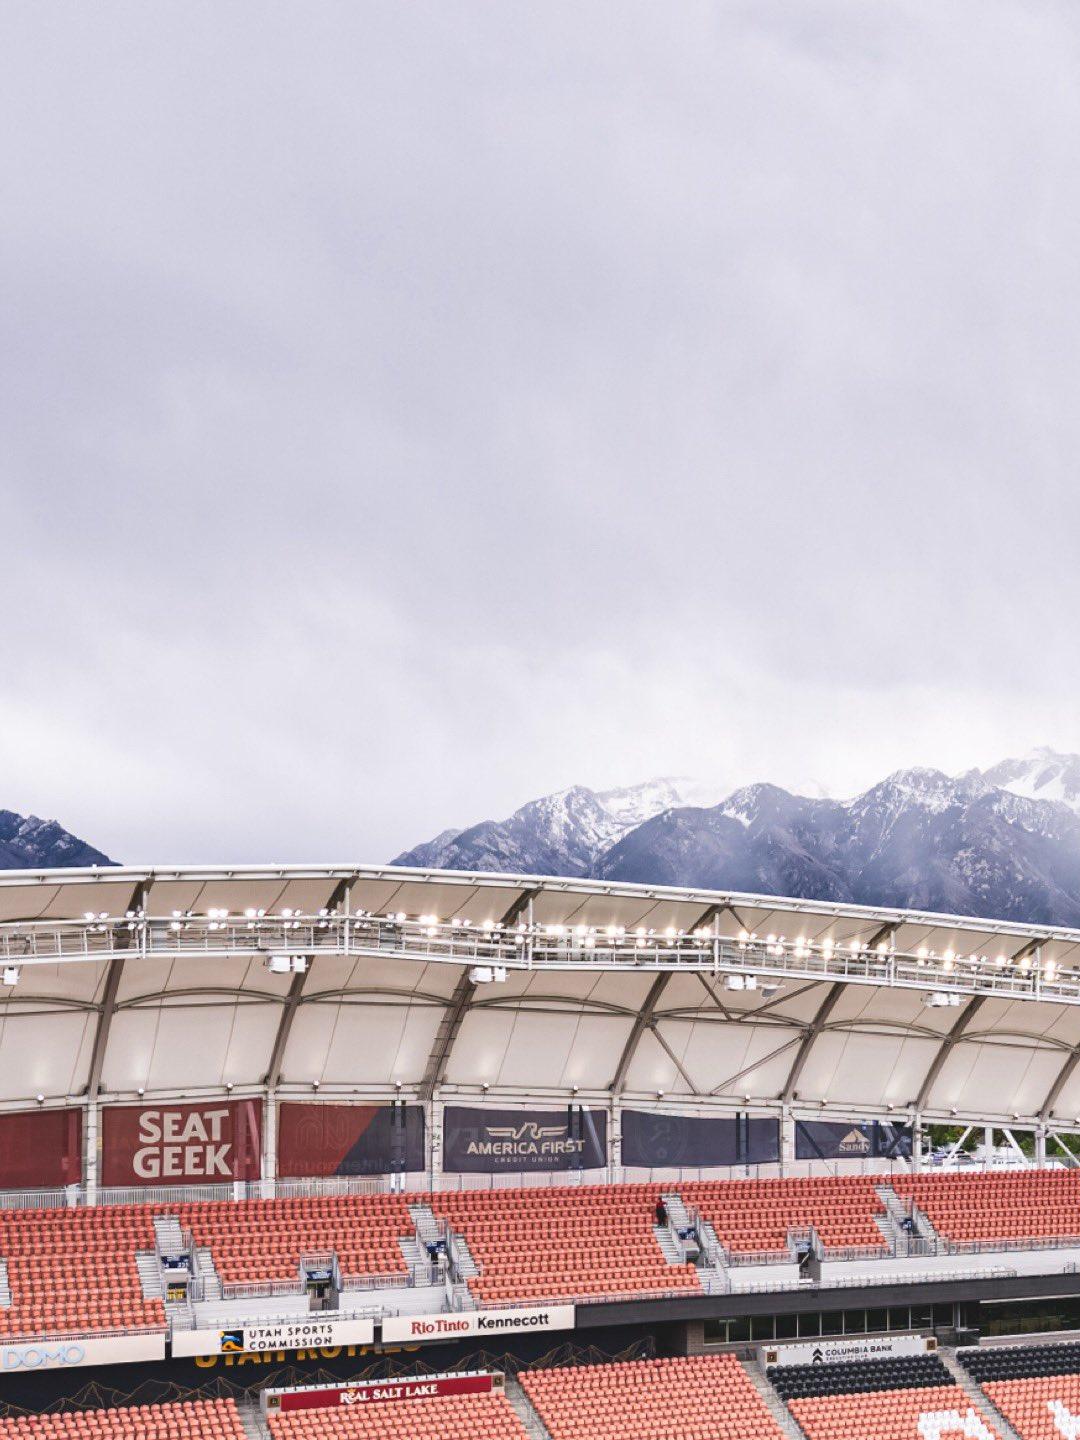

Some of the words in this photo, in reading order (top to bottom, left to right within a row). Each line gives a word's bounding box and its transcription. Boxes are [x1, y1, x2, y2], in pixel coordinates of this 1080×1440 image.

[139, 1109, 229, 1143] SEAT
[466, 1141, 538, 1155] AMERICA
[541, 1139, 585, 1154] FIRST
[840, 1141, 871, 1154] Sandy
[133, 1143, 233, 1178] GEEK
[478, 1313, 549, 1329] Kennecott
[250, 1328, 282, 1338] UTAH
[287, 1324, 333, 1336] SPORTS
[250, 1336, 333, 1350] COMMISSION
[825, 1346, 868, 1356] COLUMBIA
[870, 1345, 892, 1353] BANK
[3, 1346, 85, 1370] DOMO
[340, 1388, 370, 1404] REAL
[373, 1387, 403, 1399] SALT
[405, 1384, 438, 1396] LAKE
